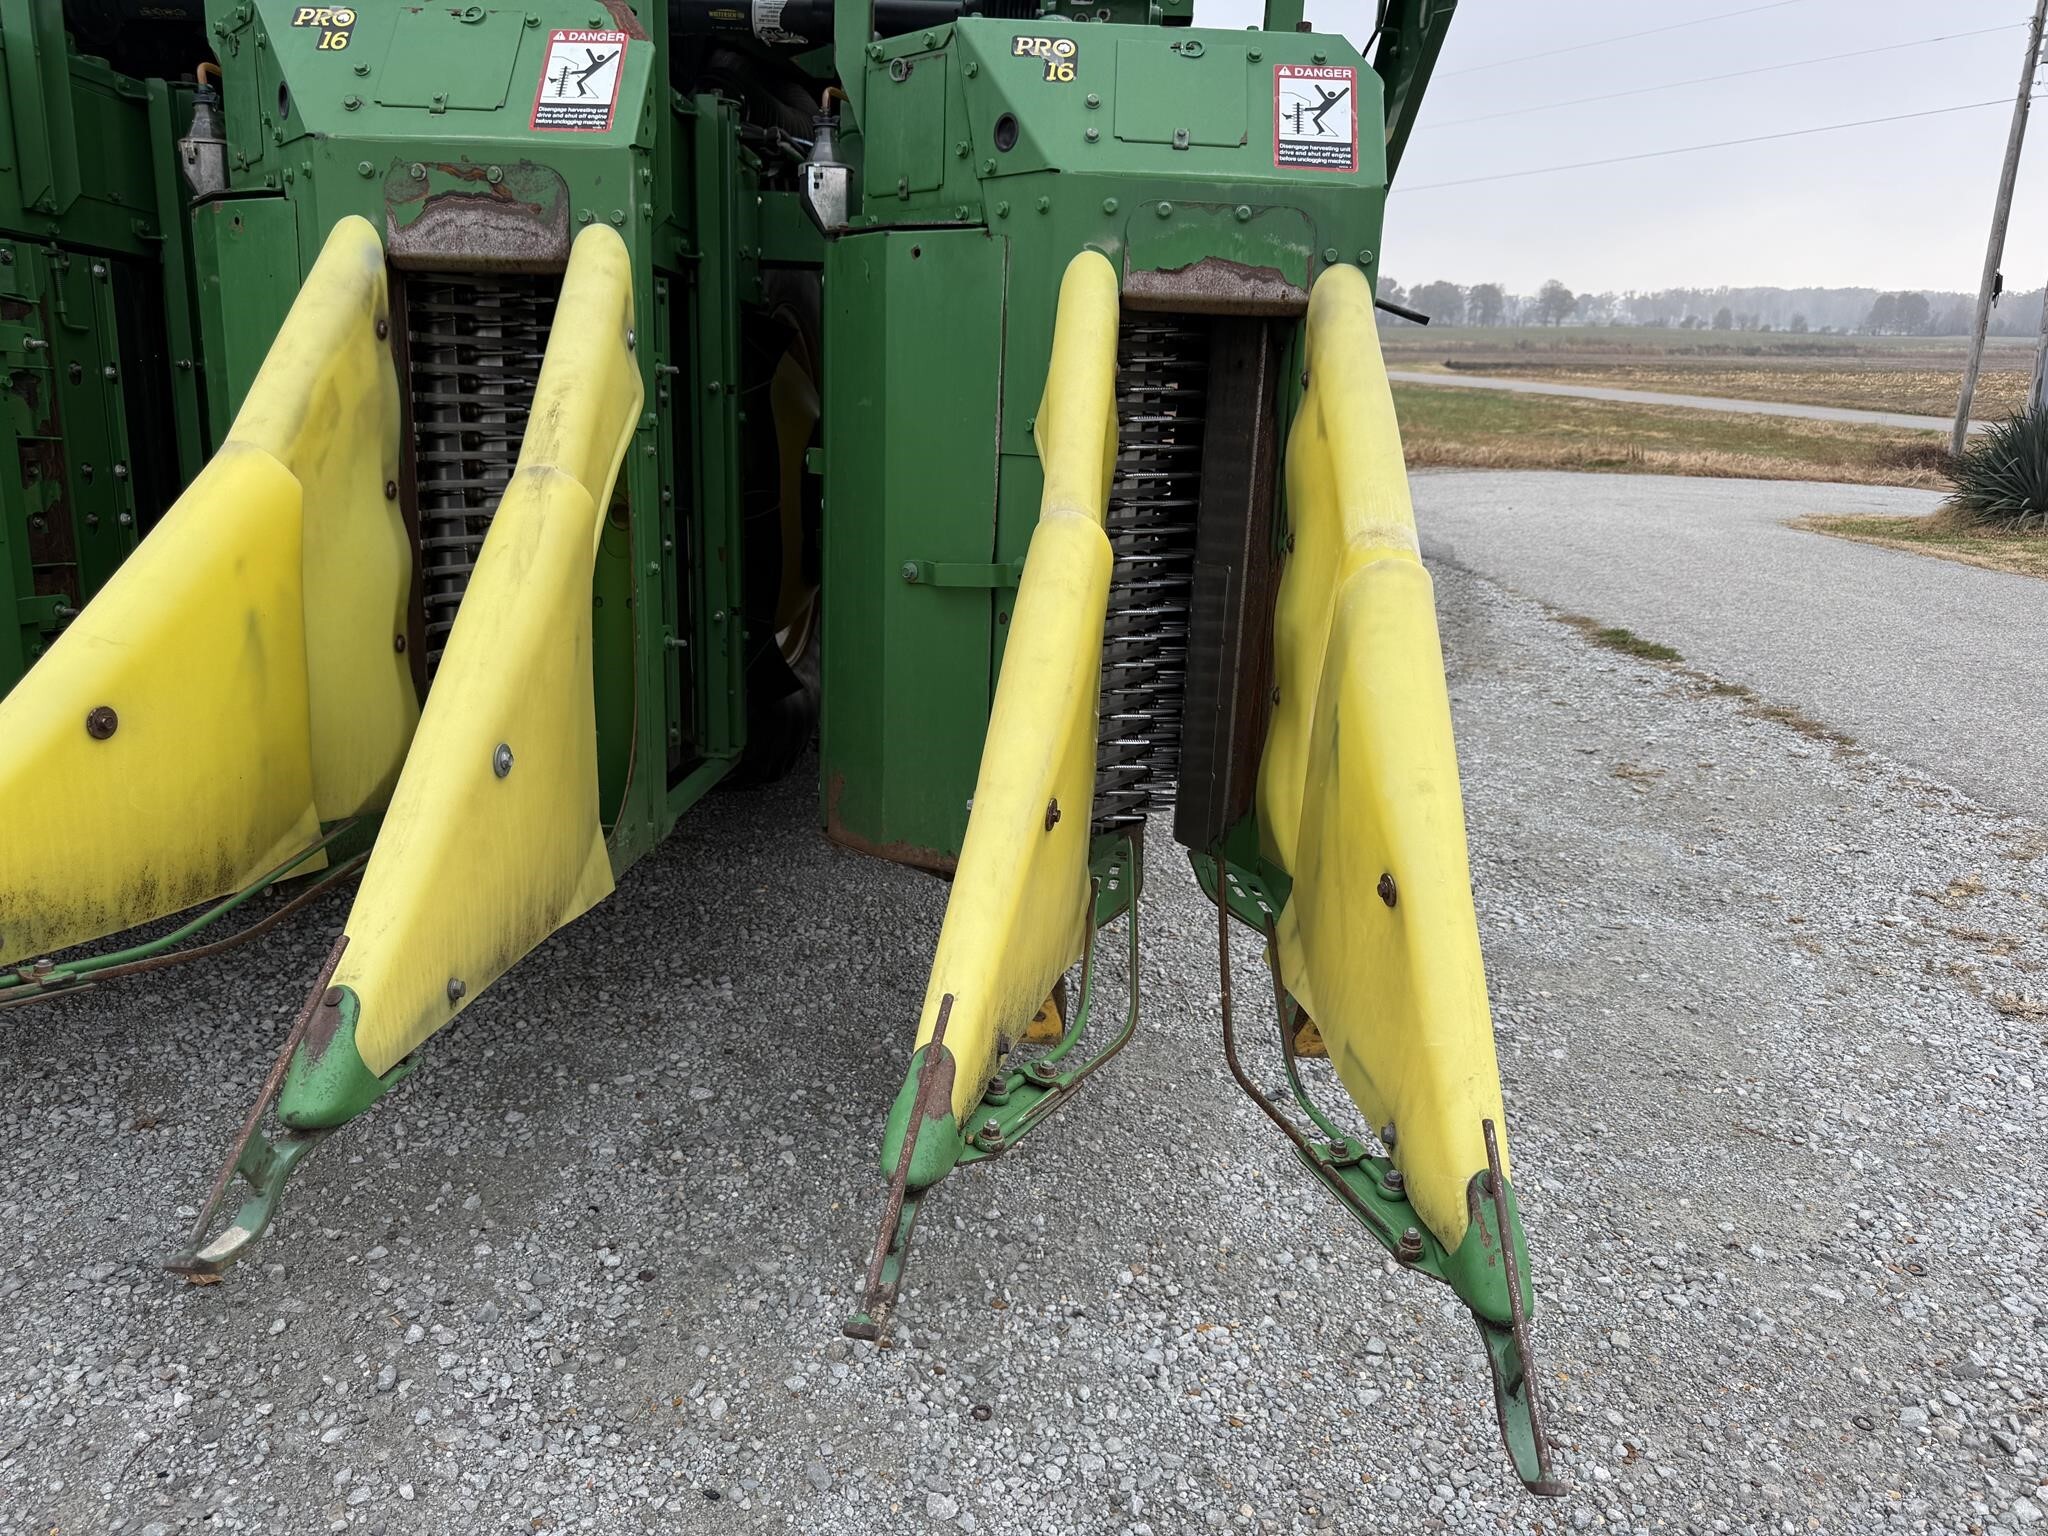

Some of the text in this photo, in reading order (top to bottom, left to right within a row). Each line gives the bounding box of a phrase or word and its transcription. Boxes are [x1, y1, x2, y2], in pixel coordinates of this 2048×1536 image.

[294, 8, 356, 27] PRO
[319, 31, 349, 50] 16
[568, 32, 625, 42] DANGER
[1014, 37, 1076, 58] PRO
[1046, 62, 1075, 82] 16
[1294, 67, 1352, 78] DANGER
